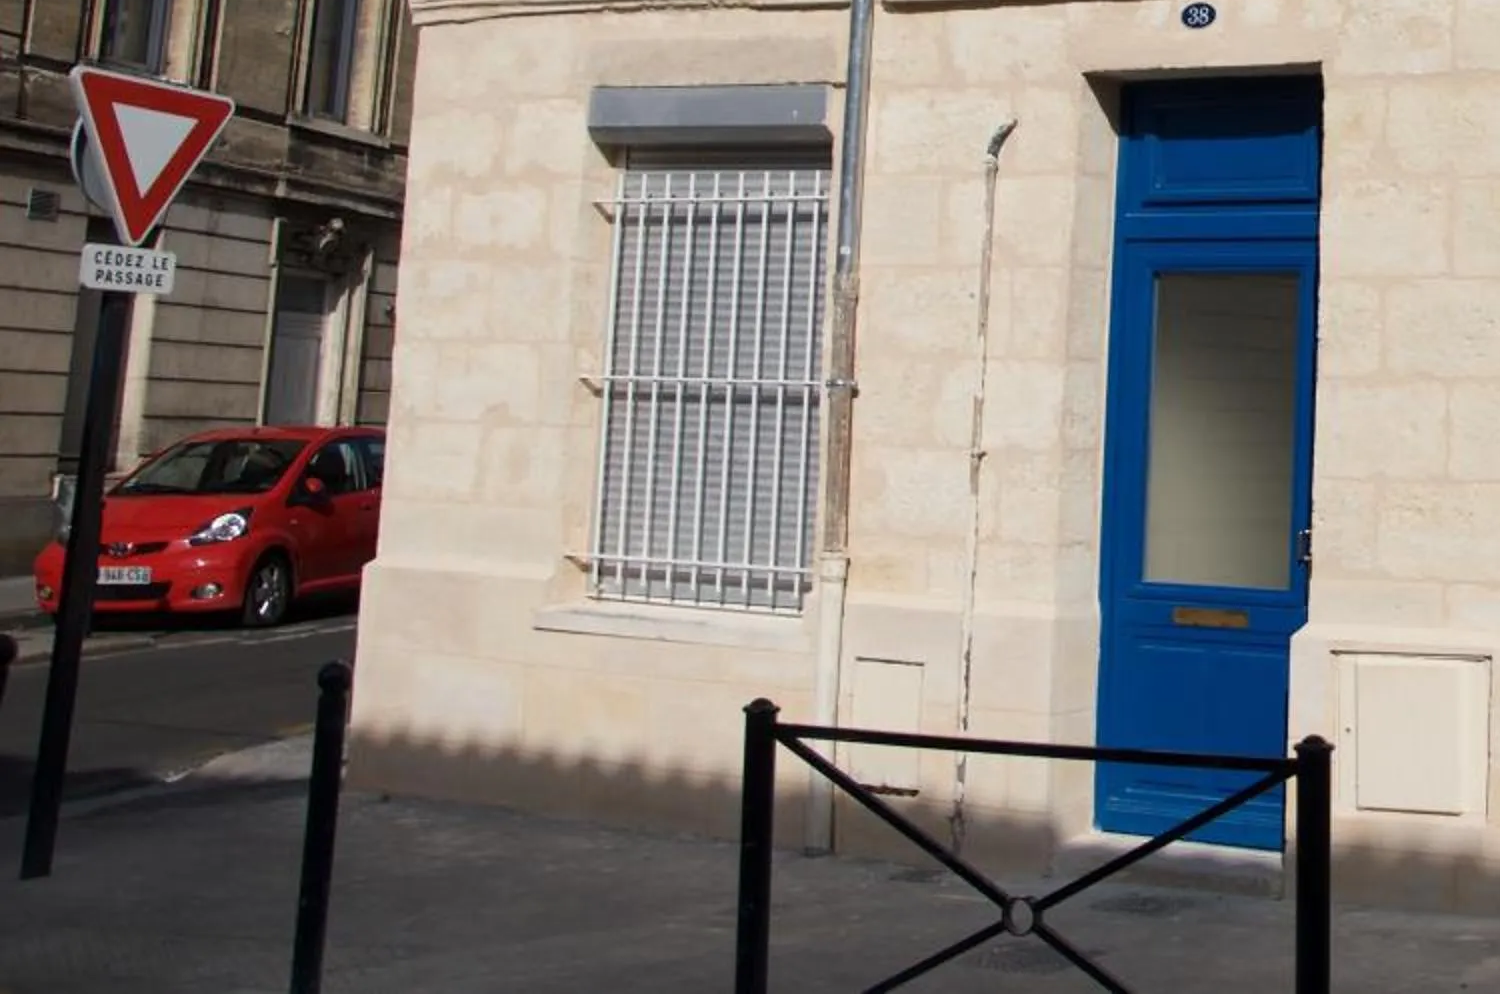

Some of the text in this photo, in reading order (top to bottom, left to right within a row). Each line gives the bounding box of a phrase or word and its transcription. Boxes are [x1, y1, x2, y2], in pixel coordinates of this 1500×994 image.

[1187, 6, 1209, 25] 38
[93, 250, 169, 271] CÉDEZ LE
[94, 269, 163, 287] PASSAGE
